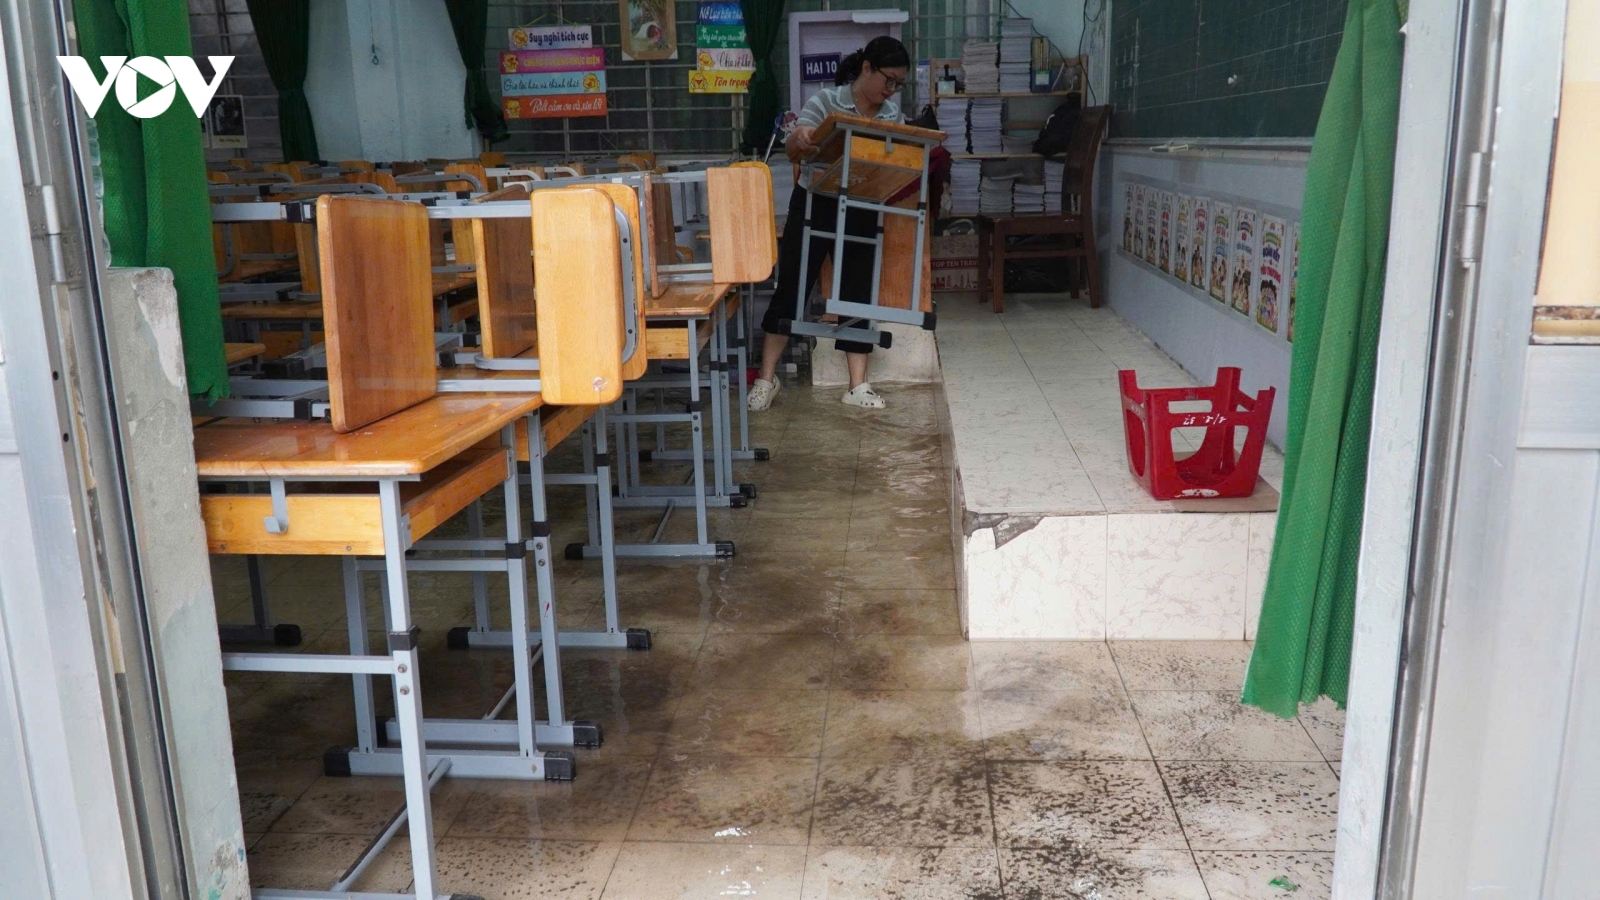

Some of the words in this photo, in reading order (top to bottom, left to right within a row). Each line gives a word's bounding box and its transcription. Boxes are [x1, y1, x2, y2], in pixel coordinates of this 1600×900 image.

[529, 33, 542, 46] Suy
[560, 31, 576, 42] tích
[577, 32, 589, 44] cực
[806, 61, 823, 75] HAI
[825, 60, 837, 74] 10
[714, 75, 727, 87] Tôn
[946, 259, 959, 267] TEN
[960, 259, 979, 267] TRAV
